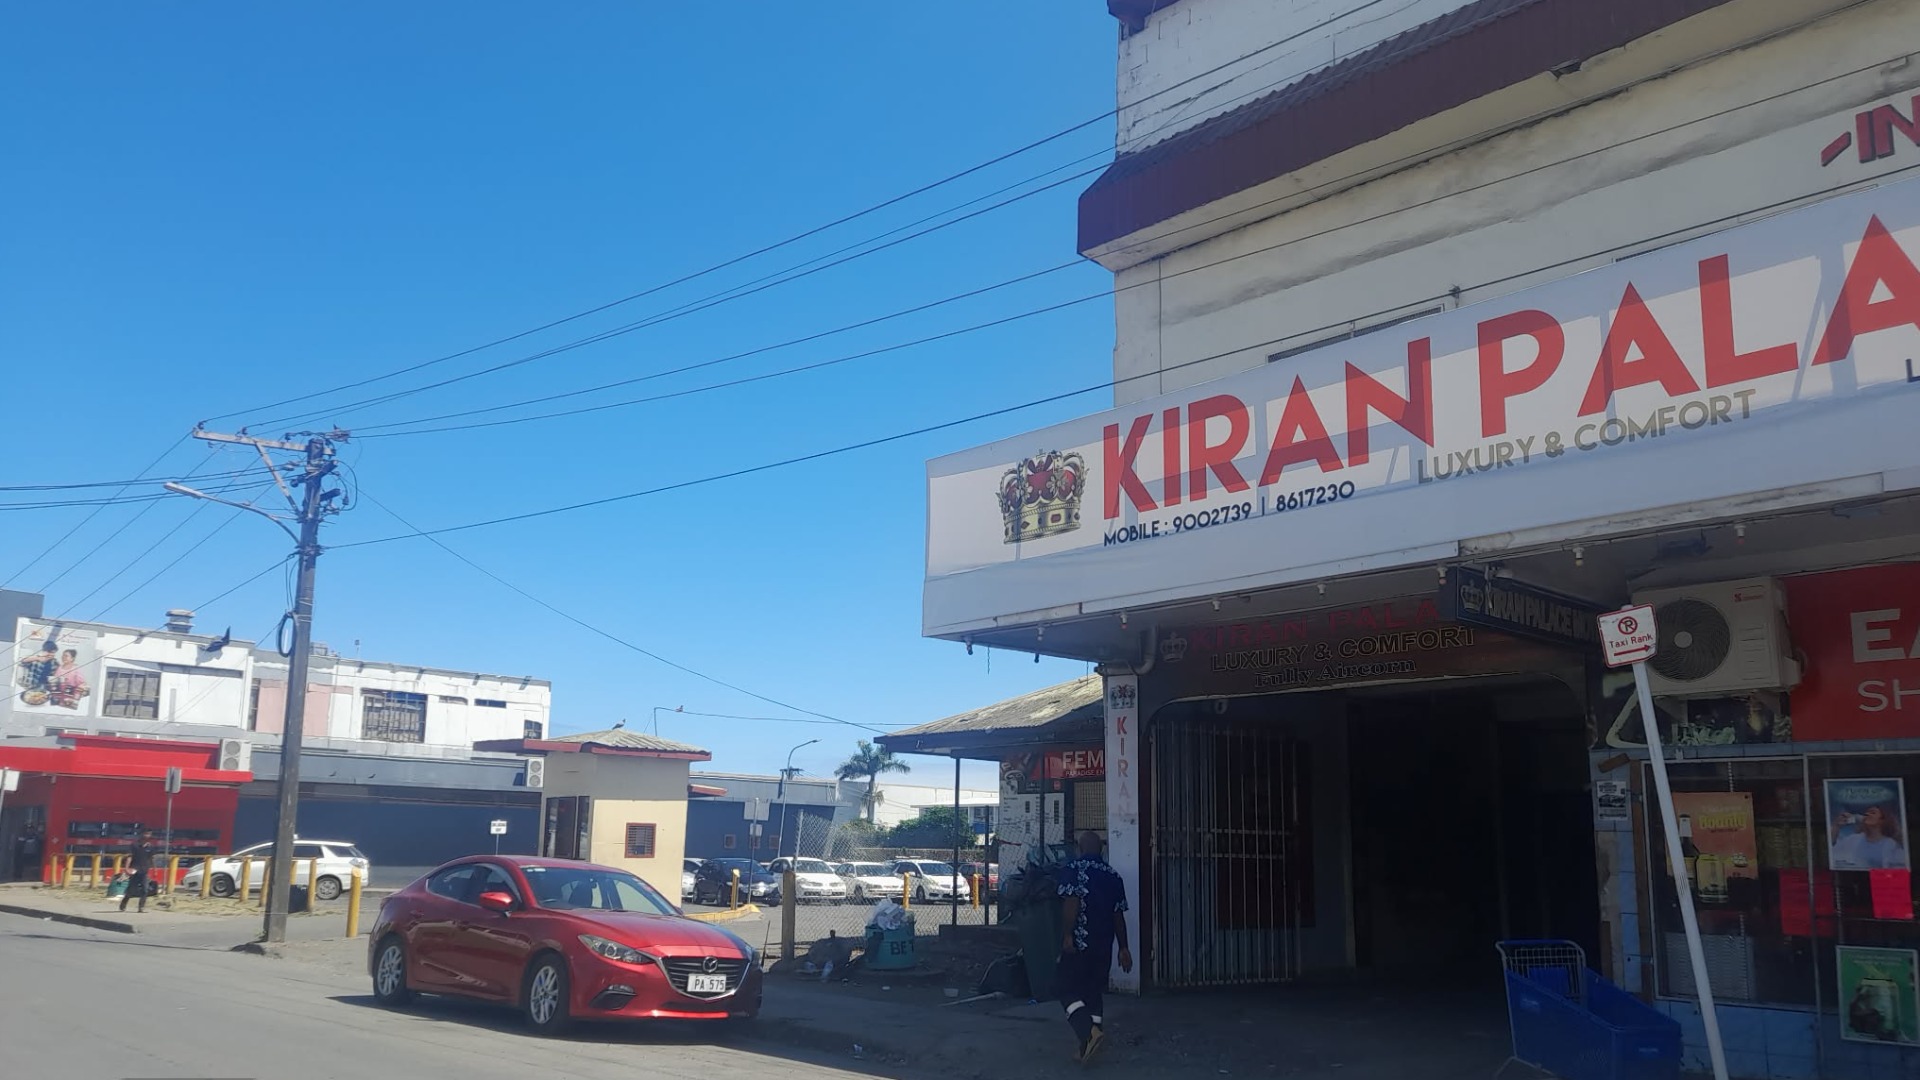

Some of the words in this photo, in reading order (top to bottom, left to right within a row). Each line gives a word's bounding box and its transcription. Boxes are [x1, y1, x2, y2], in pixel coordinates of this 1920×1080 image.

[1103, 336, 1434, 520] KIRAN
[1476, 213, 1920, 439] PALA
[1417, 436, 1535, 484] LUXURY
[1544, 431, 1565, 458] &
[1574, 388, 1756, 451] COMFORT
[1103, 520, 1160, 547] MOBILE
[1172, 501, 1252, 533] 9002739
[1276, 480, 1355, 512] 8617230
[1190, 615, 1308, 656] KIRAN
[1212, 645, 1308, 672] LUXURY
[1313, 642, 1332, 662] &
[1337, 626, 1475, 658] COMFORT
[1609, 638, 1629, 648] Taxi
[1630, 633, 1653, 645] Rank
[1254, 669, 1314, 688] Fully
[1062, 750, 1104, 769] FEM
[694, 979, 705, 990] PA
[709, 979, 725, 990] 575
